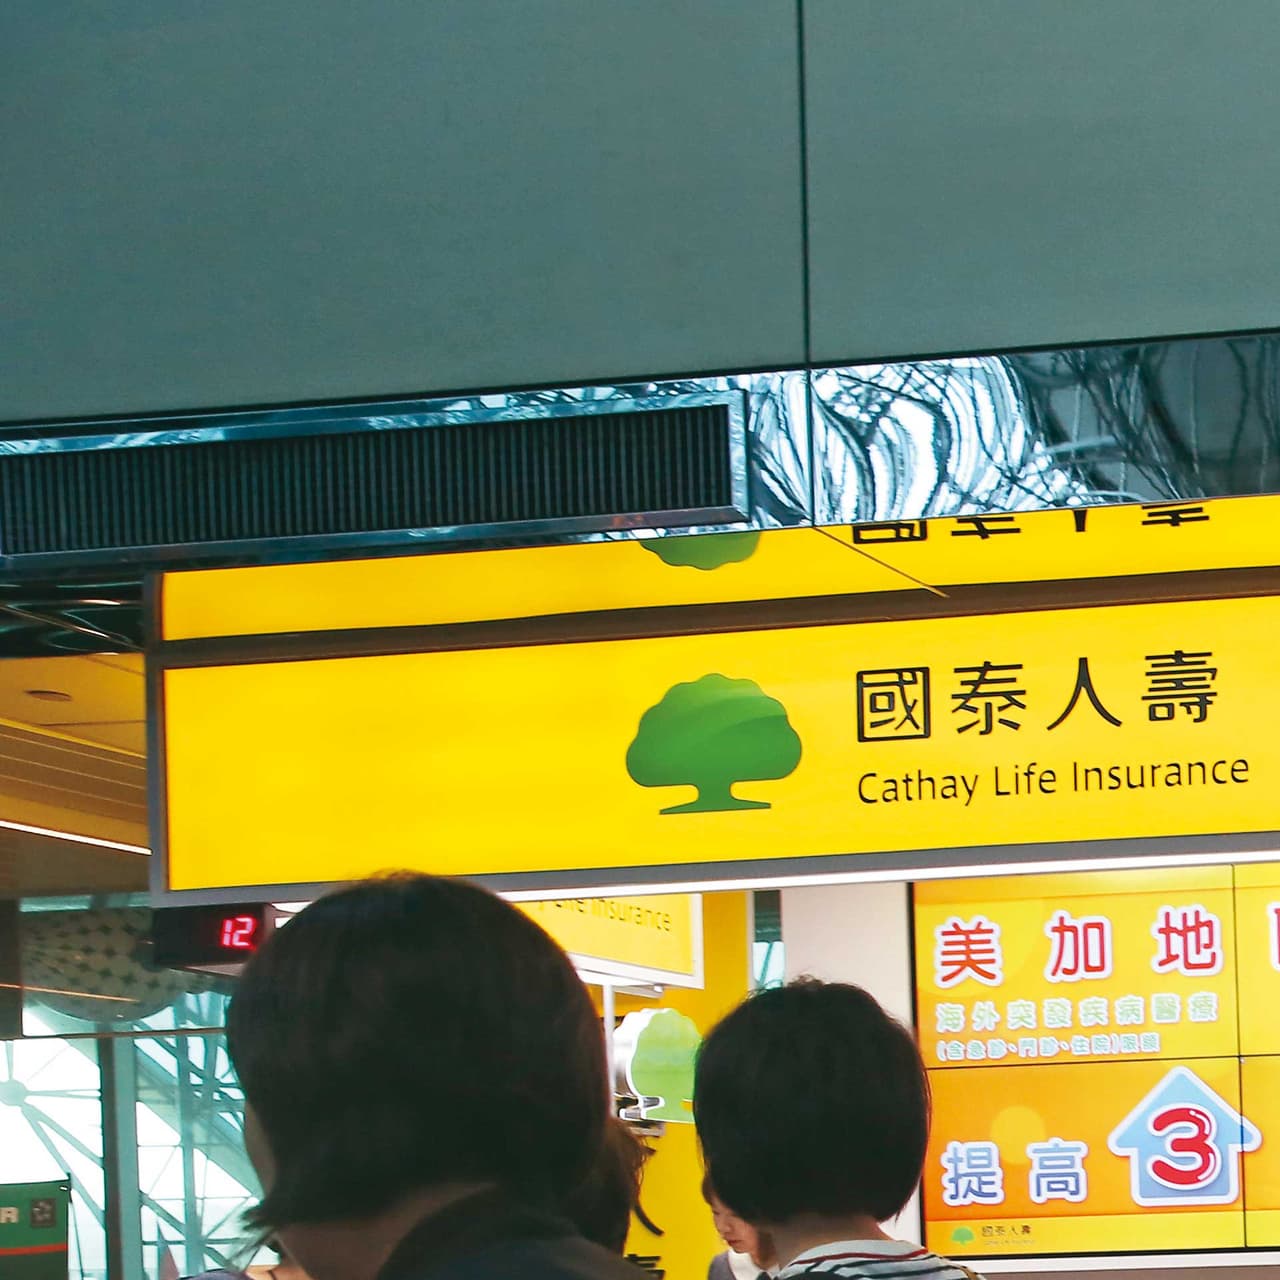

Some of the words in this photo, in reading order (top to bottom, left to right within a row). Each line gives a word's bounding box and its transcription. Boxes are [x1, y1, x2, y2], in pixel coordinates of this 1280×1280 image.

[856, 650, 1218, 743] 國泰人壽
[857, 769, 979, 806] Cathay
[994, 763, 1057, 797] Life
[1073, 758, 1250, 793] Insurance
[221, 916, 256, 948] 12
